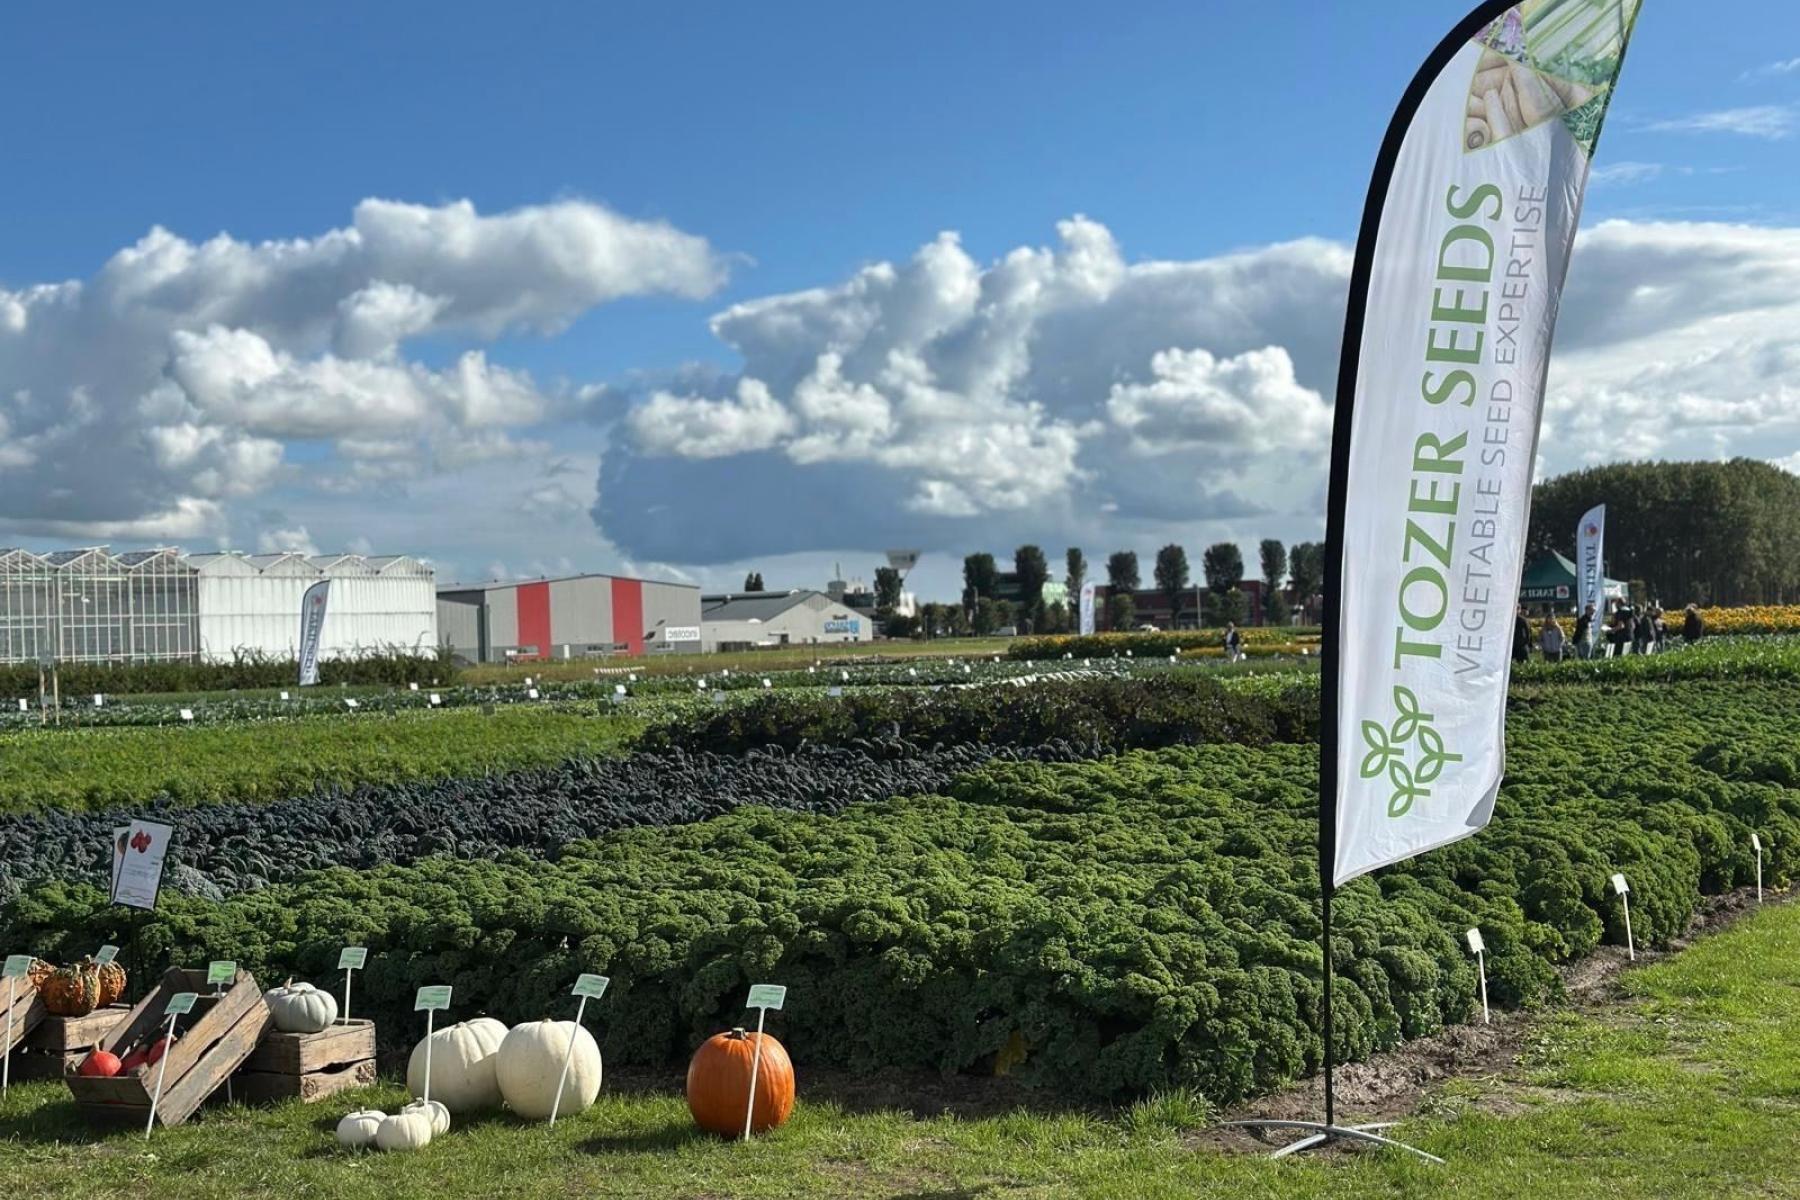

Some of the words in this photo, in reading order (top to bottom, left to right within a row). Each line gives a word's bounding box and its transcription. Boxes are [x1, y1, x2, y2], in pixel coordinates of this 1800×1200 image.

[1421, 183, 1503, 408] SEEDS
[1494, 184, 1548, 365] EXPERTISE
[1480, 378, 1513, 468] SEED
[1393, 430, 1469, 670] TOZER
[1454, 478, 1502, 675] VEGETABLE
[1586, 544, 1597, 585] TAKII
